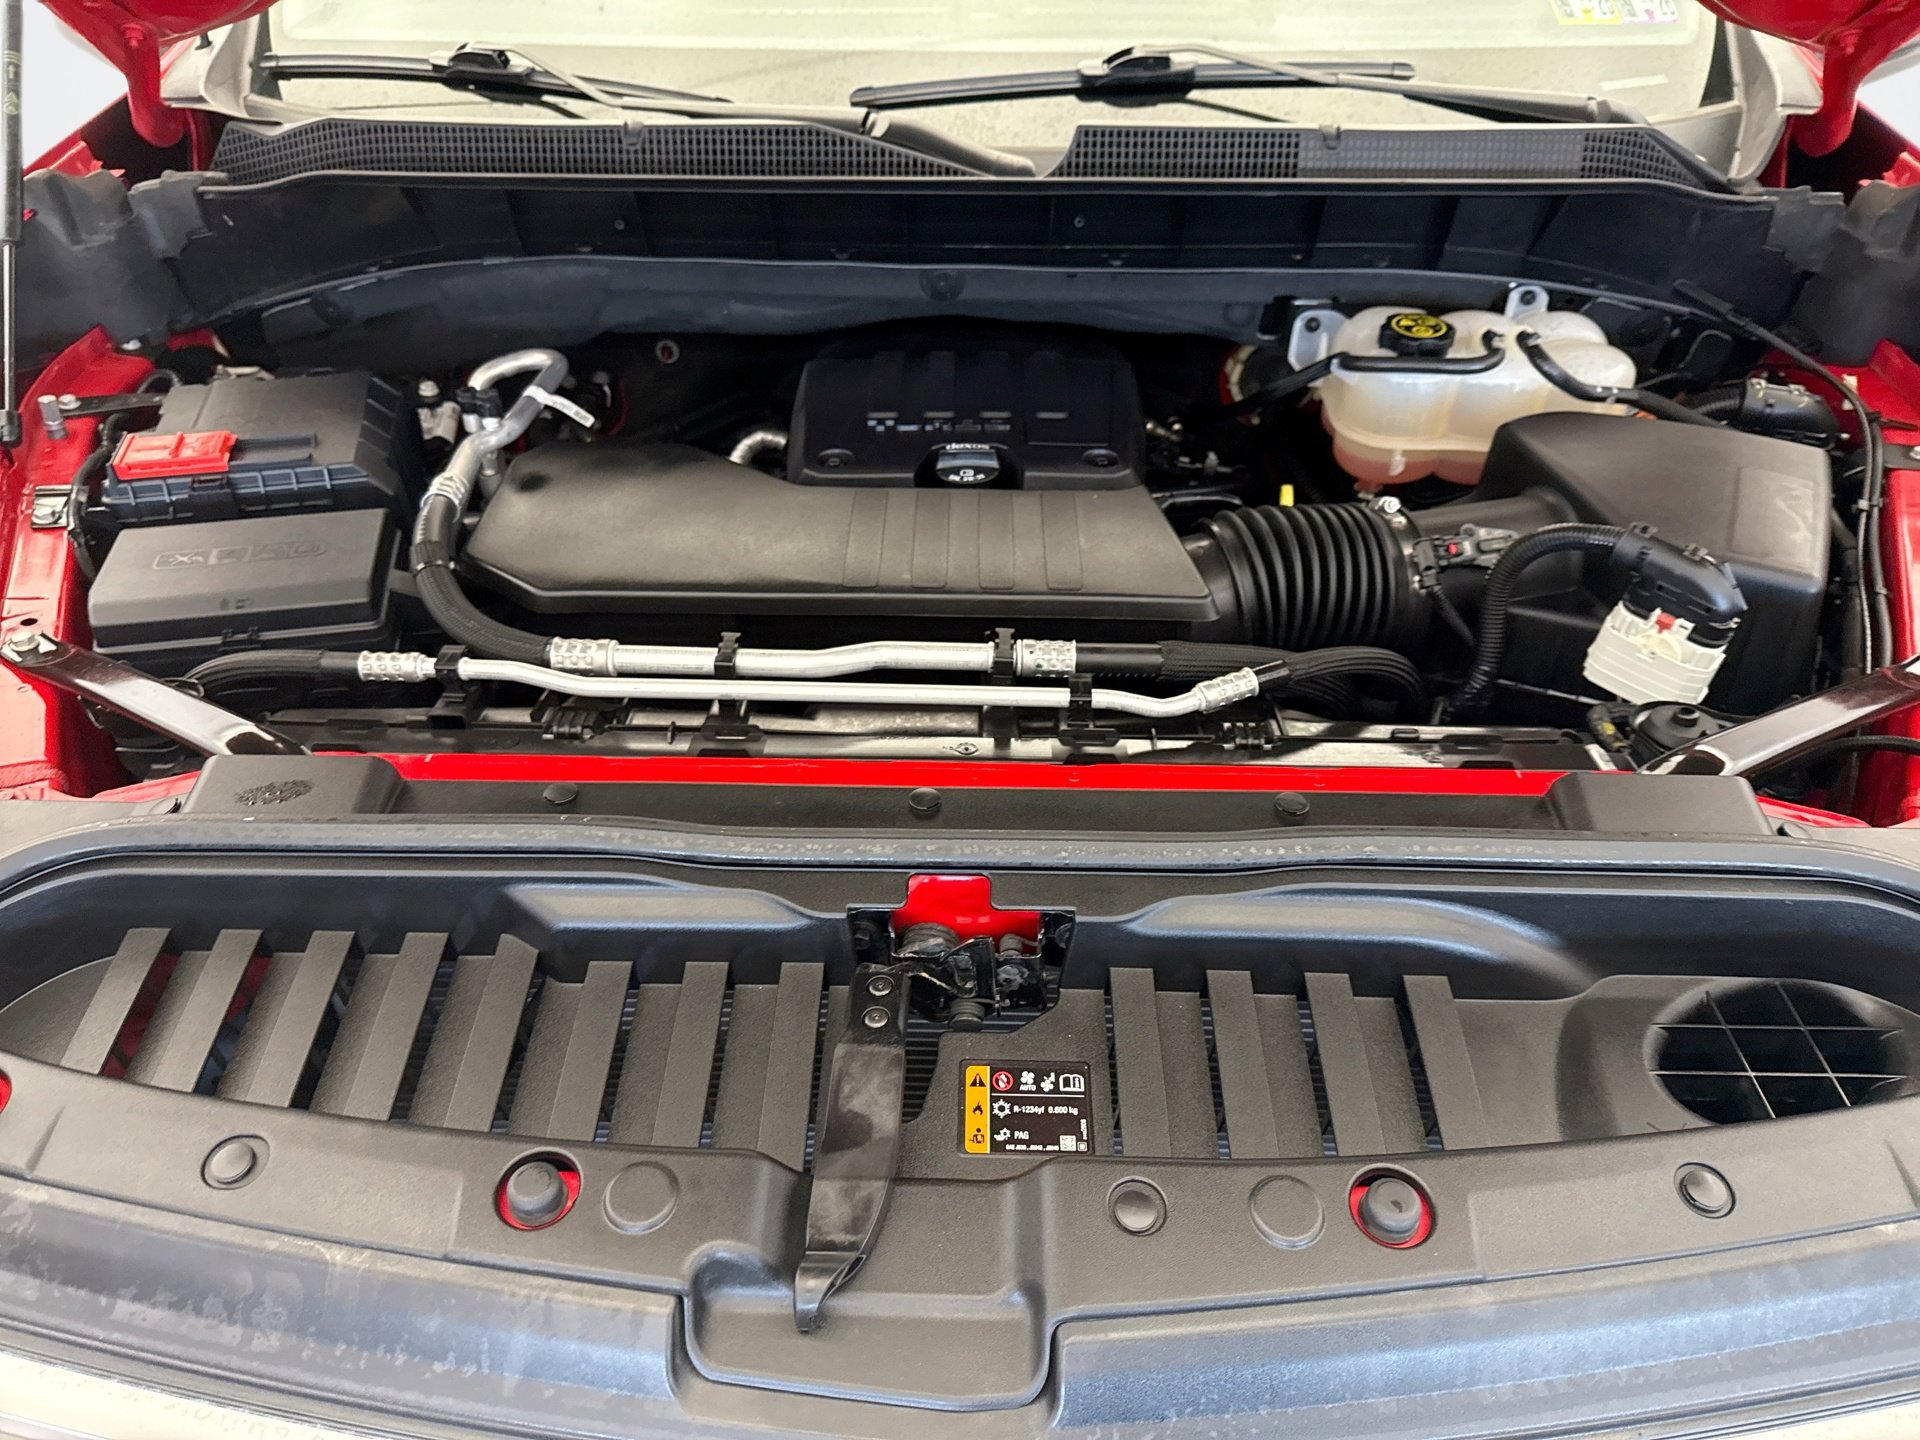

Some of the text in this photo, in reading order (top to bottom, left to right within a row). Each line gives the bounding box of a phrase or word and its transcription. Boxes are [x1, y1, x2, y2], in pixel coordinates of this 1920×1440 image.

[1013, 1105, 1045, 1115] R-1234yf
[1069, 1106, 1078, 1115] kg
[1014, 1131, 1029, 1139] PAG
